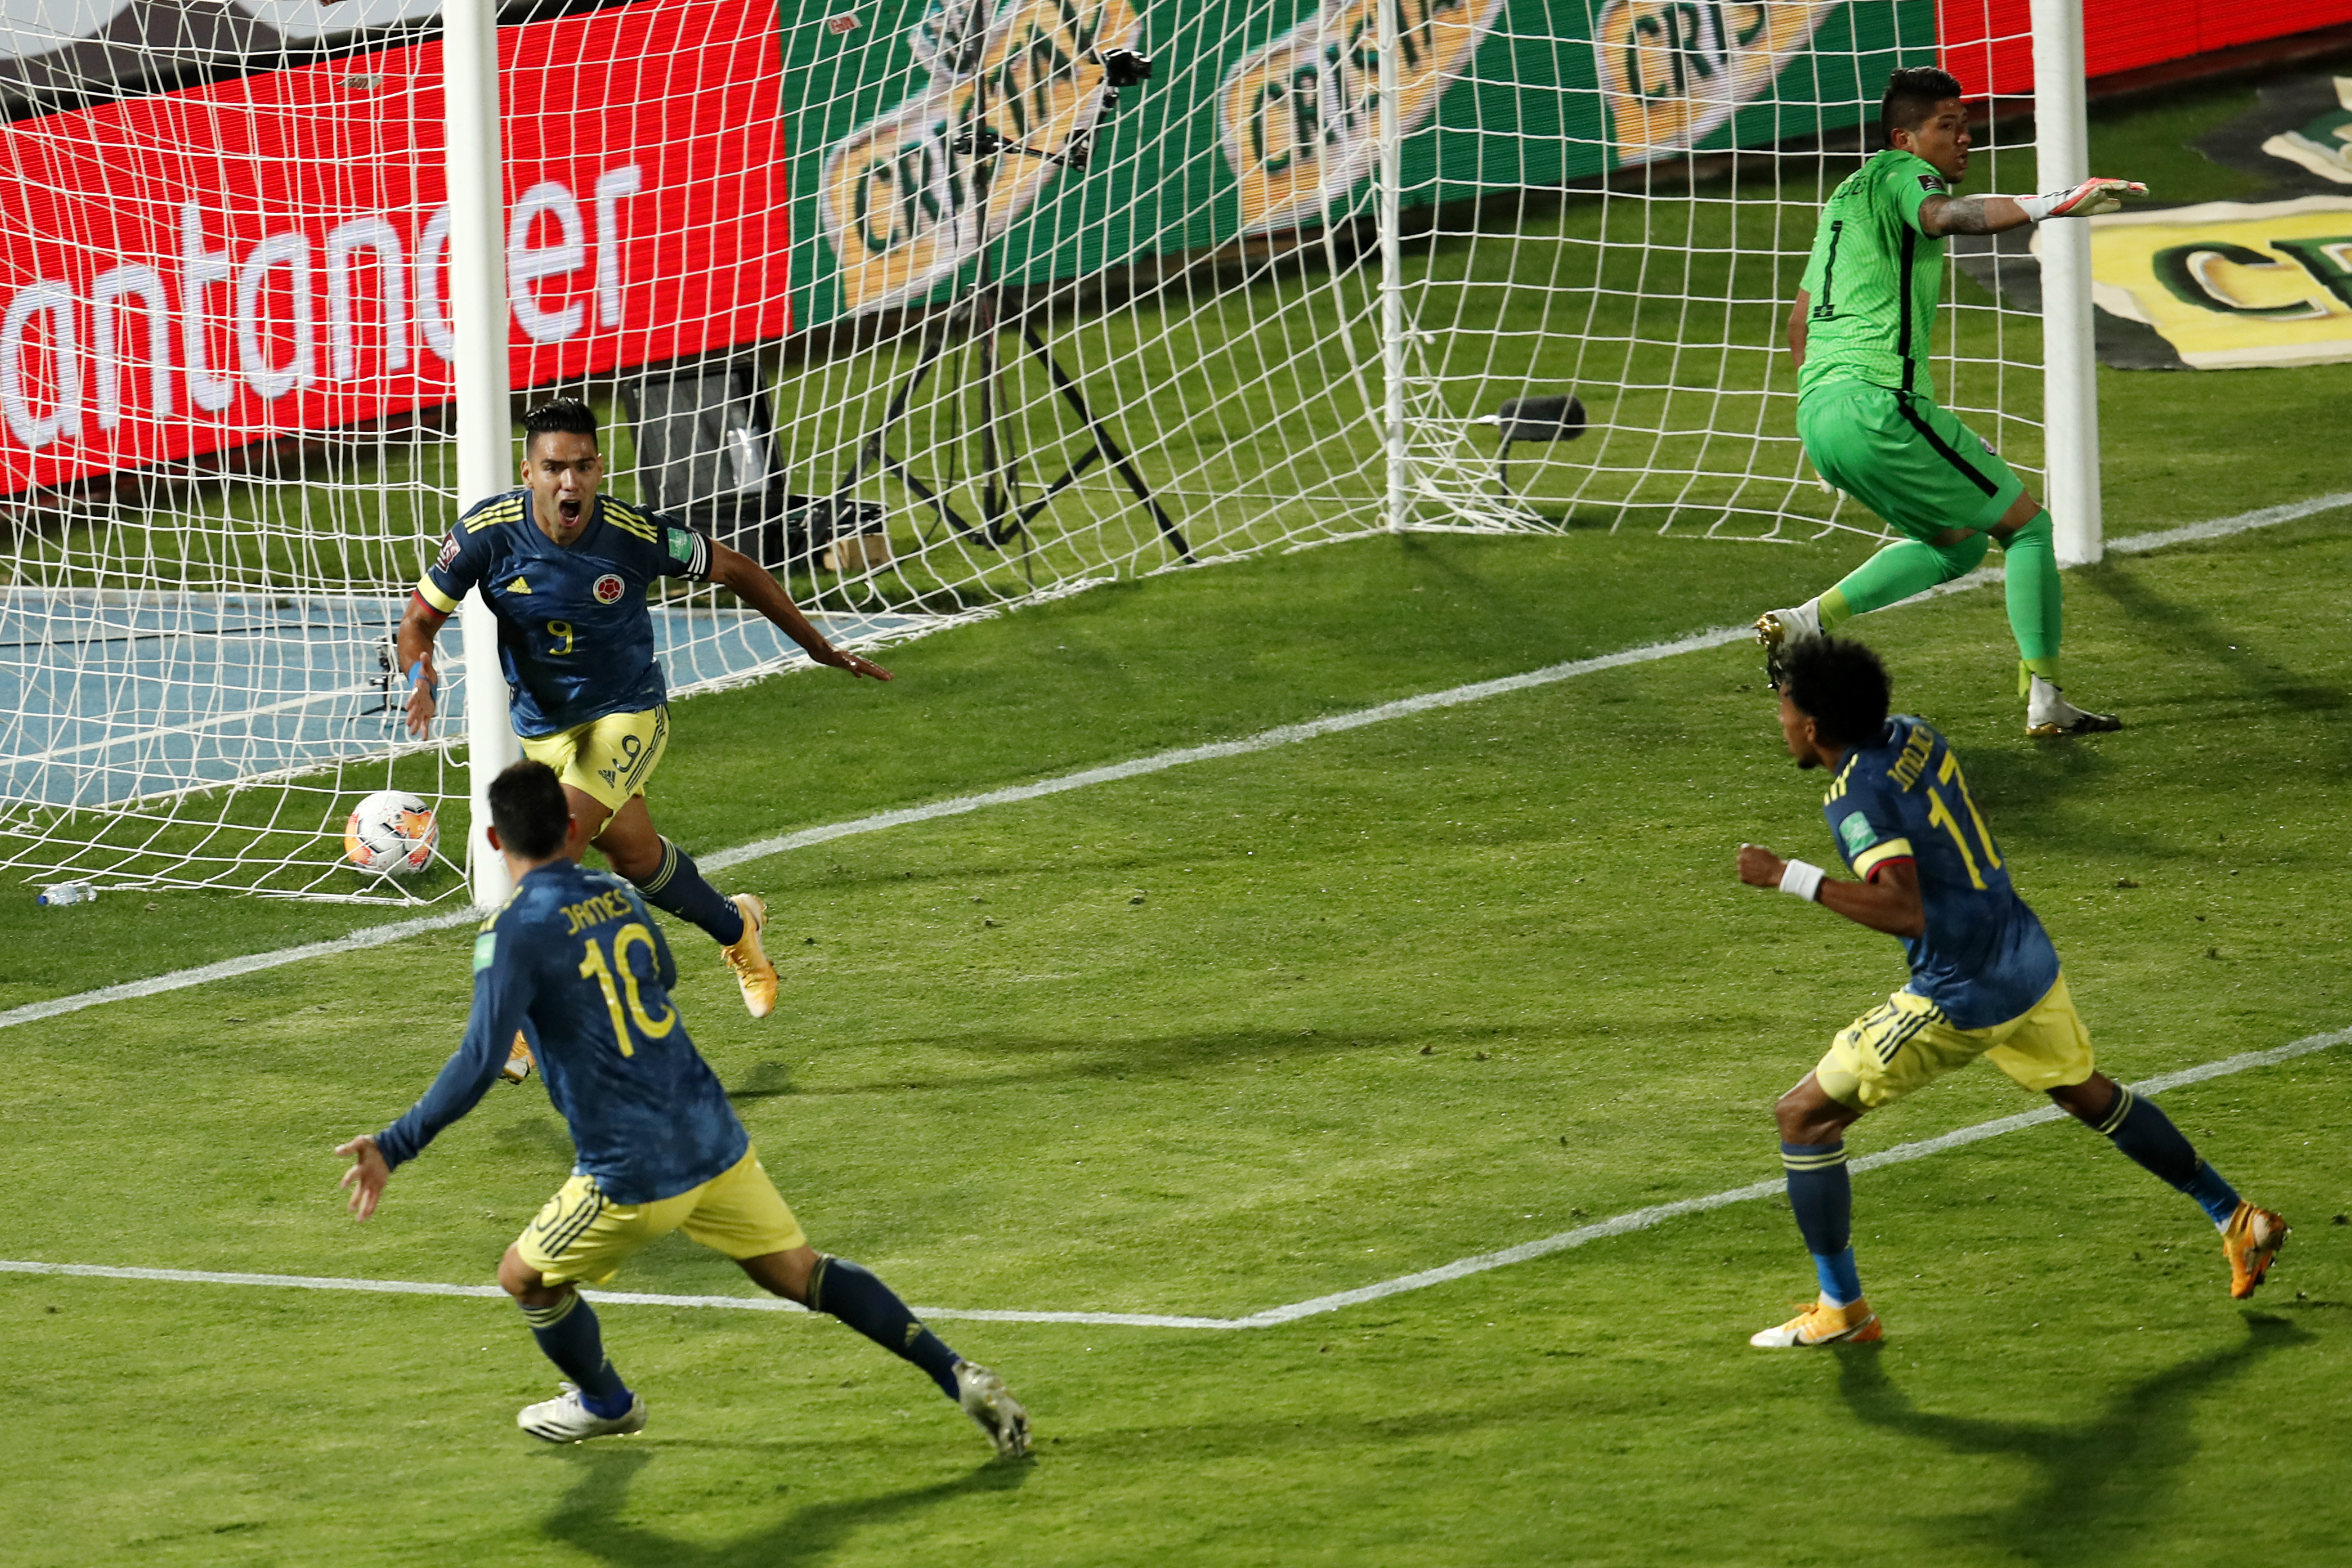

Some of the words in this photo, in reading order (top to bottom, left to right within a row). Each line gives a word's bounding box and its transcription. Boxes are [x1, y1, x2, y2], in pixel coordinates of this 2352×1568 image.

[1813, 220, 1843, 318] 1
[547, 619, 573, 656] 9
[612, 734, 641, 773] 9
[1927, 749, 2002, 890] 17
[558, 888, 634, 936] JAMES
[578, 922, 677, 1058] 10
